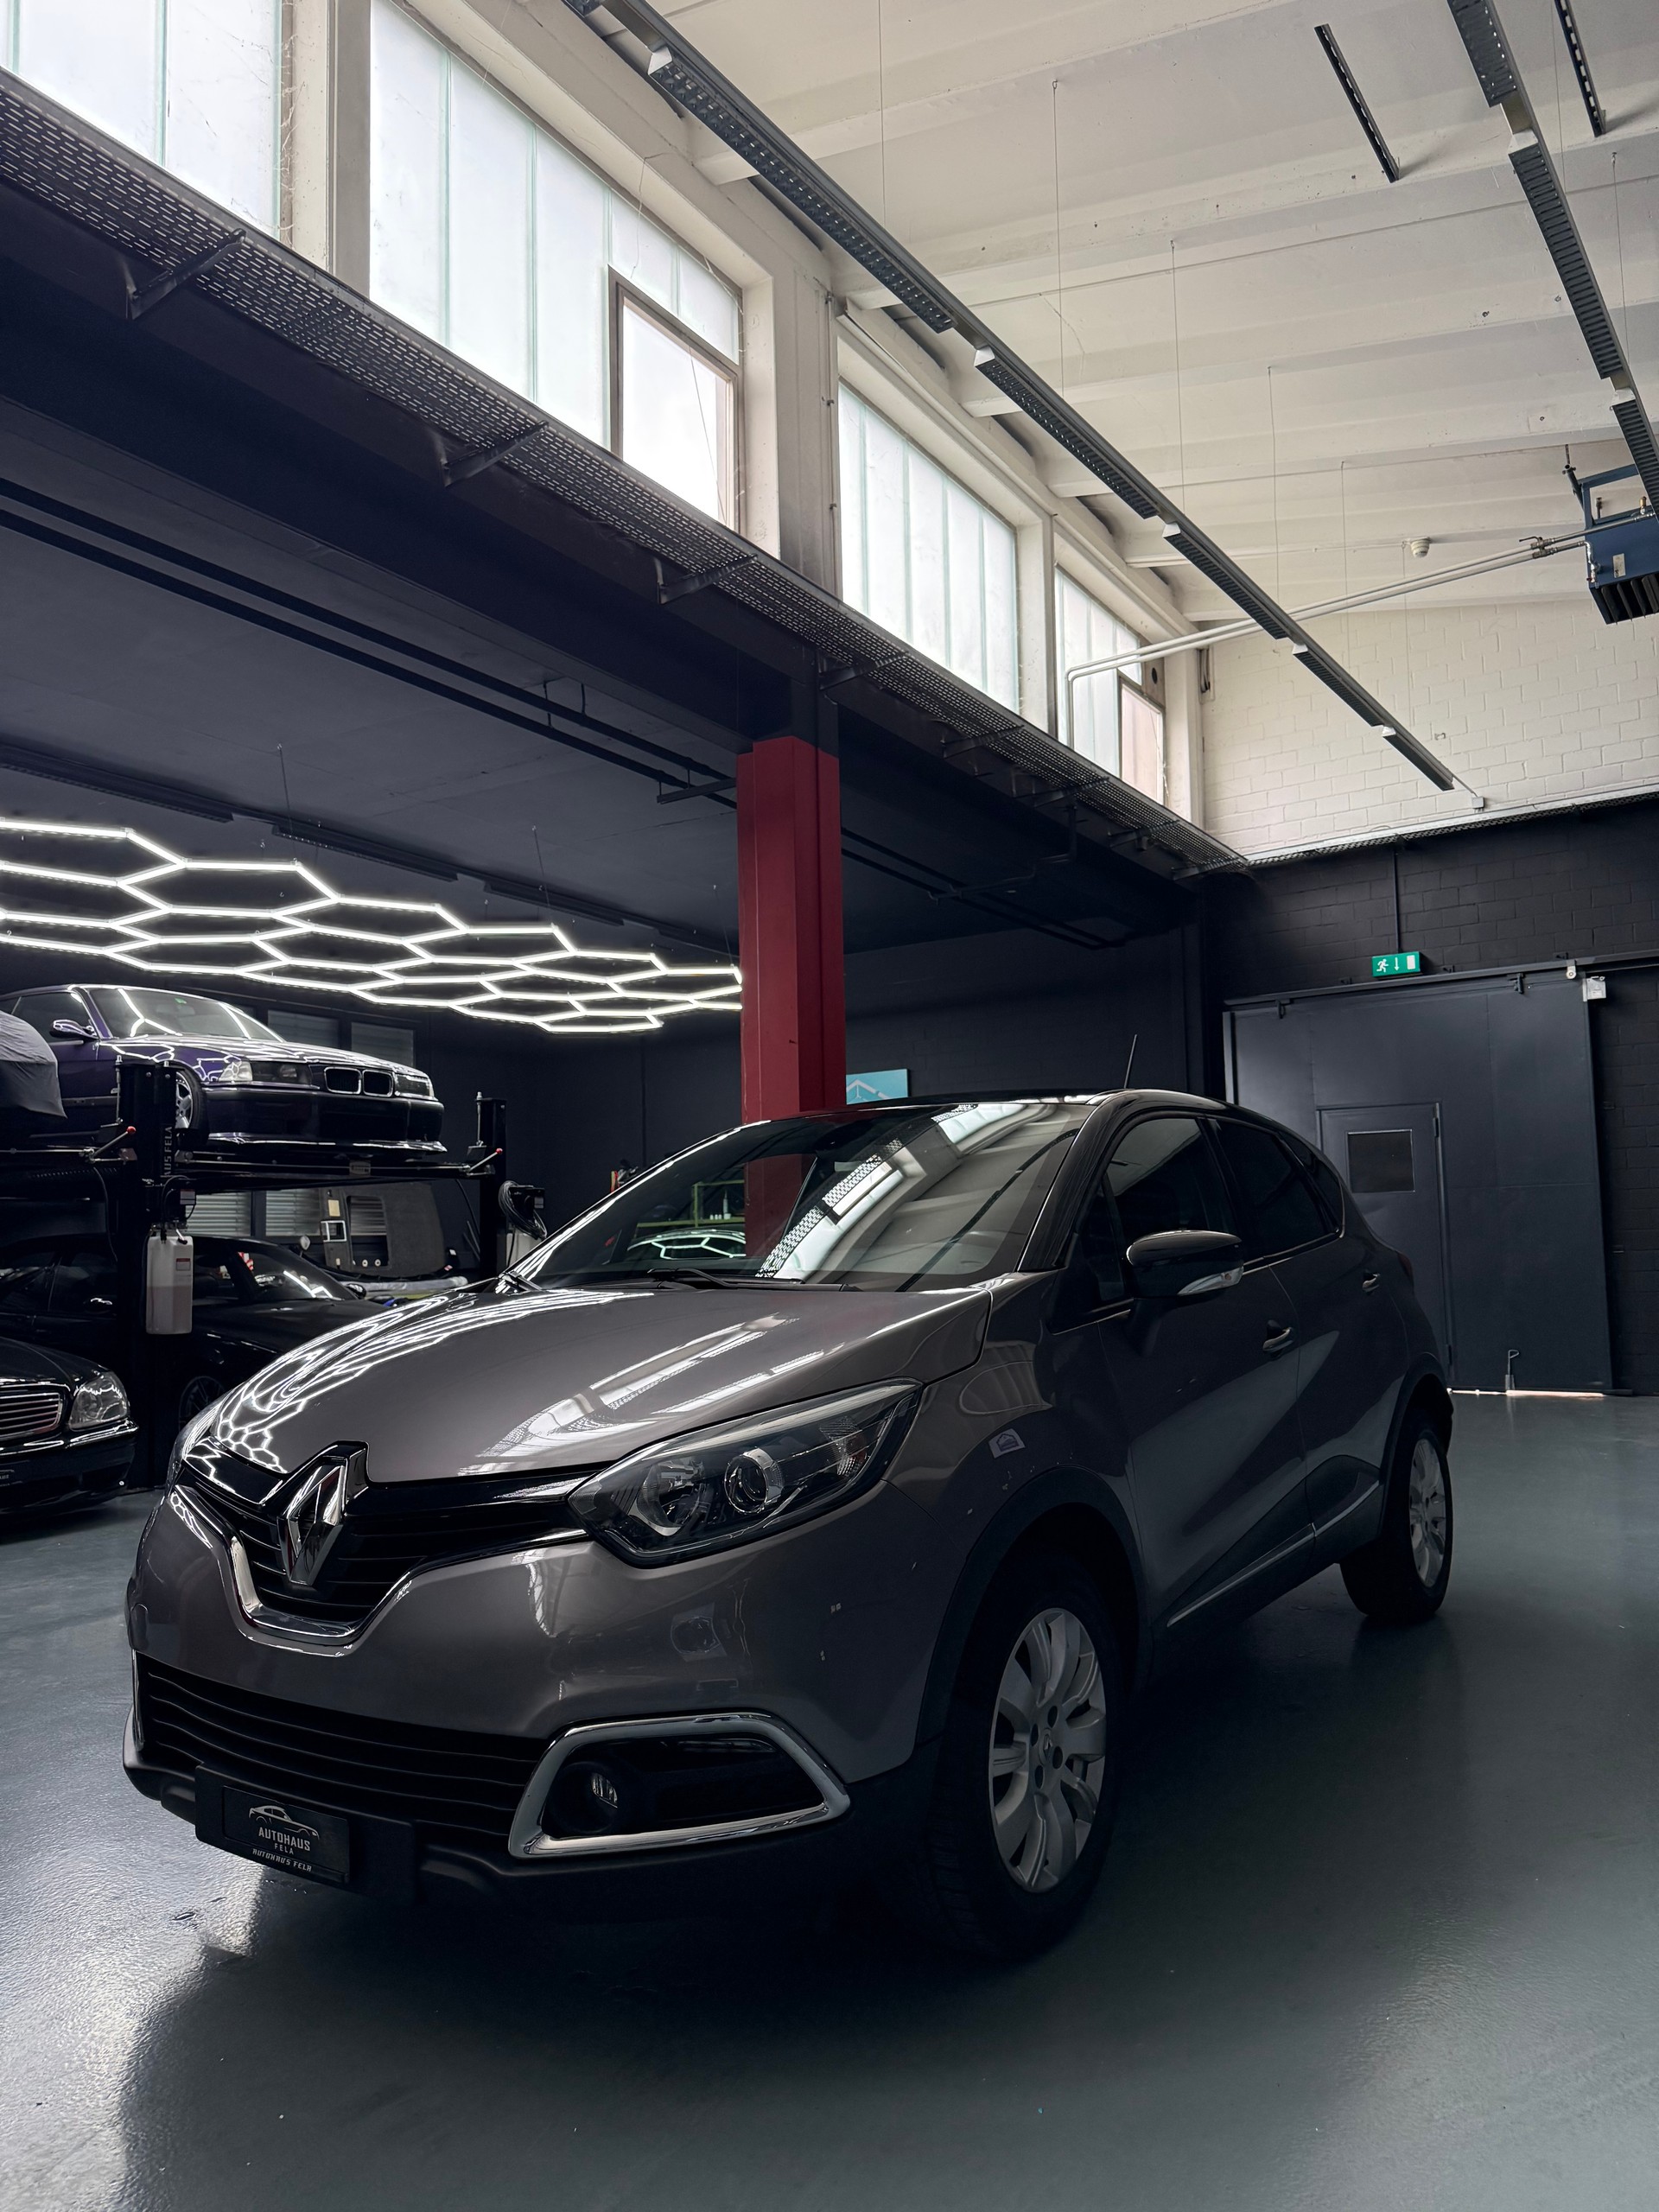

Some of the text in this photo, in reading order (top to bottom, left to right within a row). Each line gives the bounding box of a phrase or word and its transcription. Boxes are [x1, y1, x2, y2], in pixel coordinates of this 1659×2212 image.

[164, 1127, 173, 1152] FELA
[258, 1827, 310, 1851] AUTOHAUS
[274, 1842, 294, 1855] FELA
[252, 1848, 312, 1872] AUTOHAUS FELA
